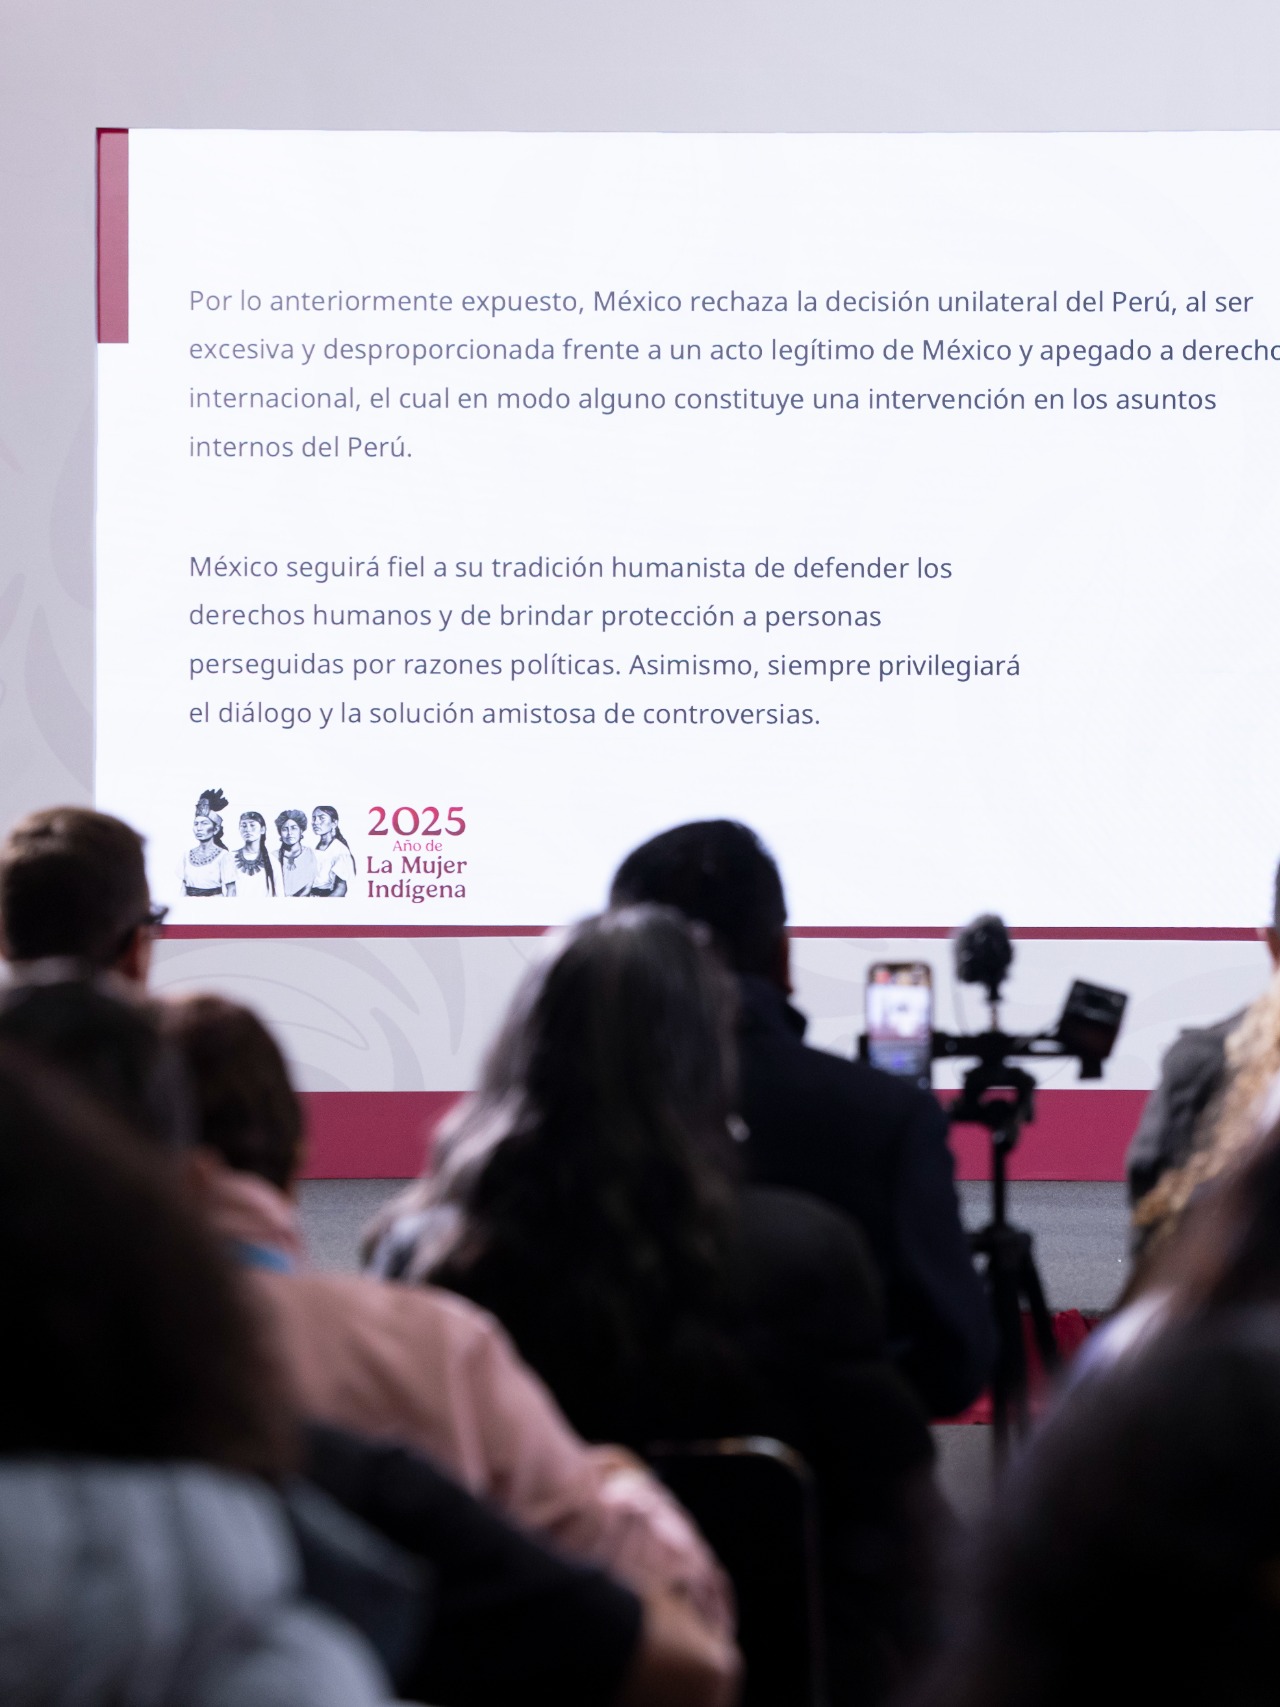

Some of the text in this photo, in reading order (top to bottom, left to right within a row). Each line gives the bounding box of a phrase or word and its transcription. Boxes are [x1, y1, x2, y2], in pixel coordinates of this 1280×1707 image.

[190, 289, 1254, 318] Por lo anteriormente expuesto, México rechaza la decisión unilateral del Perú, al ser
[189, 338, 294, 360] excesiva
[301, 343, 316, 366] y
[323, 337, 555, 366] desproporcionada
[562, 337, 640, 360] frente
[647, 344, 661, 360] a
[670, 344, 701, 361] un
[710, 340, 763, 361] acto
[772, 338, 875, 367] legítimo
[882, 338, 914, 361] de
[923, 338, 1012, 361] México
[1018, 344, 1034, 367] y
[1040, 338, 1152, 367] apegado
[1159, 344, 1174, 361] a
[190, 386, 1217, 416] internacional, el cual en modo alguno constituye una intervención en los asuntos
[190, 435, 412, 458] internos del Perú.
[190, 555, 953, 584] México seguirá fiel a su tradición humanista de defender los
[189, 603, 882, 634] derechos humanos y de brindar protección a personas
[190, 652, 1020, 683] perseguidas por razones políticas. Asimismo, siempre privilegiará
[189, 701, 820, 730] el diálogo y la solución amistosa de controversias.
[367, 806, 466, 836] 2025
[392, 839, 443, 852] Año de
[366, 856, 467, 879] La Mujer
[367, 878, 467, 904] Indígena
